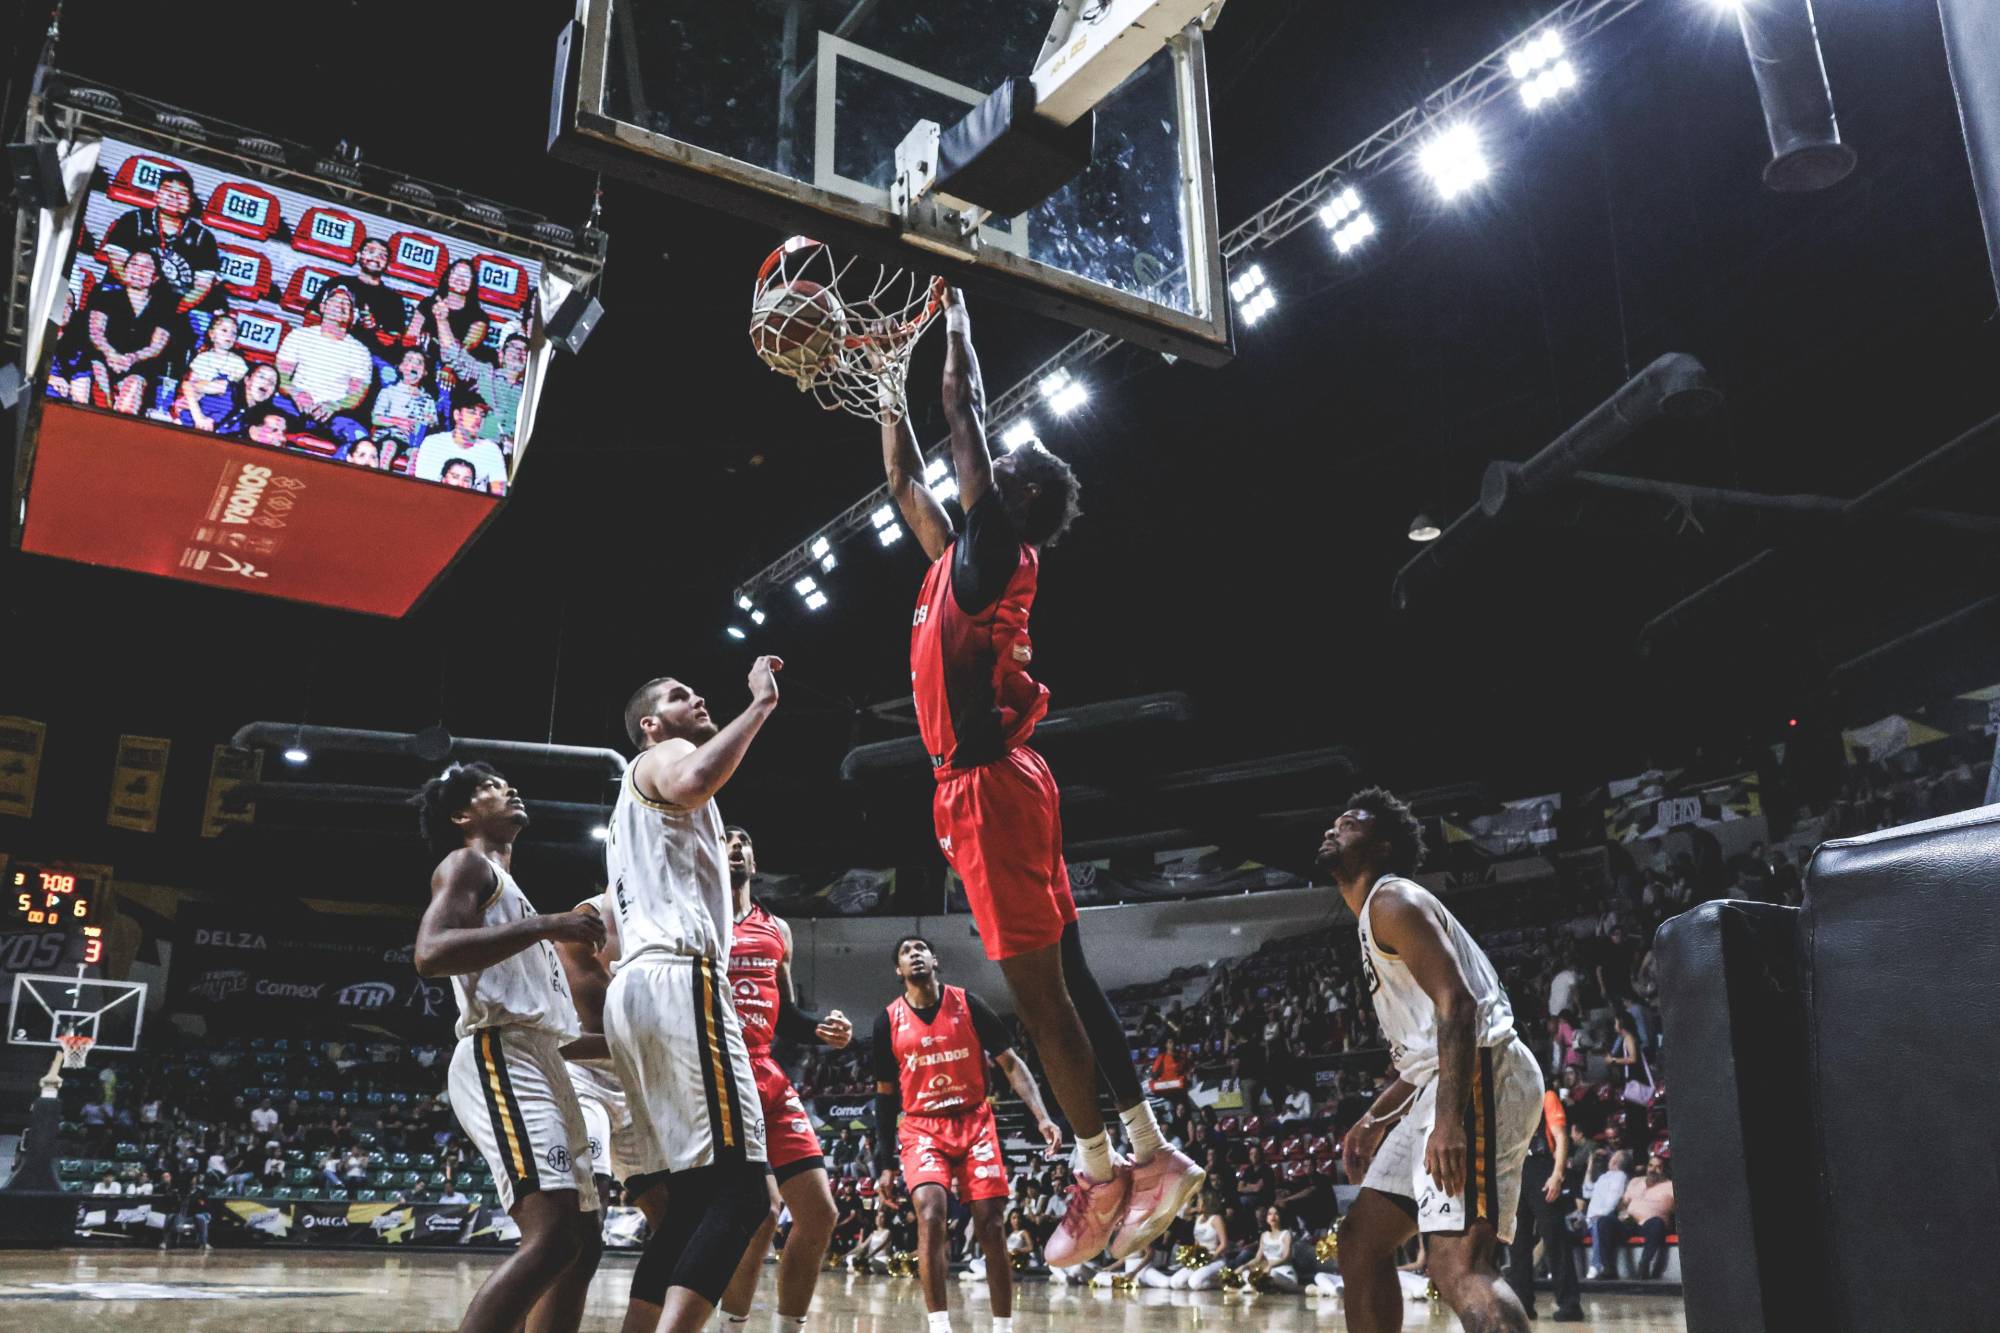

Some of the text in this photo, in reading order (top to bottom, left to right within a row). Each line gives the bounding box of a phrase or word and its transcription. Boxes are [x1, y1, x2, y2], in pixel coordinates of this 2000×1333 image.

[228, 194, 259, 218] 018
[316, 217, 346, 241] 019
[401, 241, 434, 266] 020
[483, 265, 510, 288] 021
[239, 319, 276, 344] 027
[220, 463, 272, 524] SONORA
[39, 872, 75, 894] 7:08
[18, 893, 32, 912] 5
[73, 899, 88, 918] 6
[84, 938, 102, 963] 3
[195, 928, 267, 950] DELZA
[255, 979, 326, 999] Comex
[337, 988, 384, 1008] LTH
[829, 1104, 867, 1117] Comex
